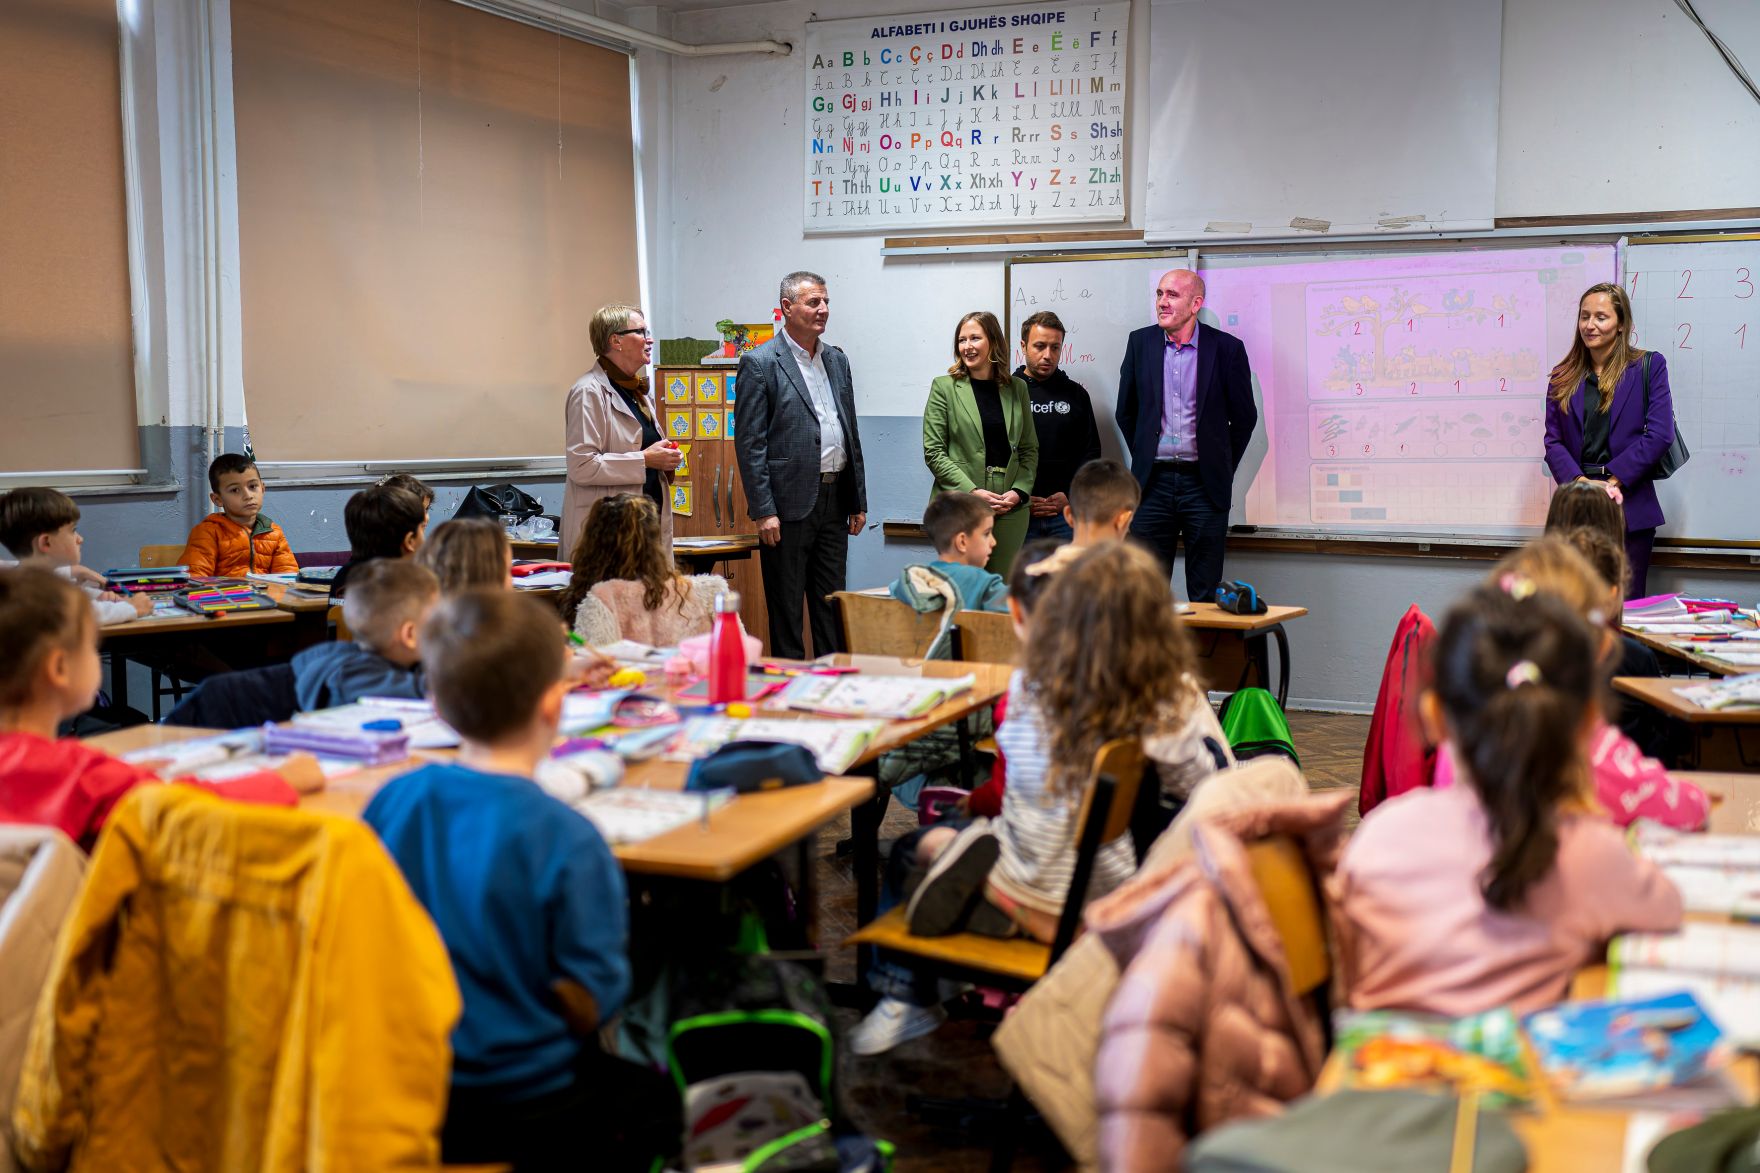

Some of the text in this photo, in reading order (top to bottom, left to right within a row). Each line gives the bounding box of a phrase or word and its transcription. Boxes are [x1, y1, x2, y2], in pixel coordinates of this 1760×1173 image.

[871, 11, 1066, 40] ALFABETI I GJUHËS SHQIPE
[1631, 267, 1754, 300] 1 2 3
[1015, 287, 1026, 306] A
[1030, 295, 1038, 304] a
[1354, 313, 1505, 335] 2 1 1
[1677, 323, 1692, 350] 2
[1734, 323, 1746, 349] 1
[1355, 377, 1507, 396] 3 2 1 2
[1030, 400, 1054, 413] icef
